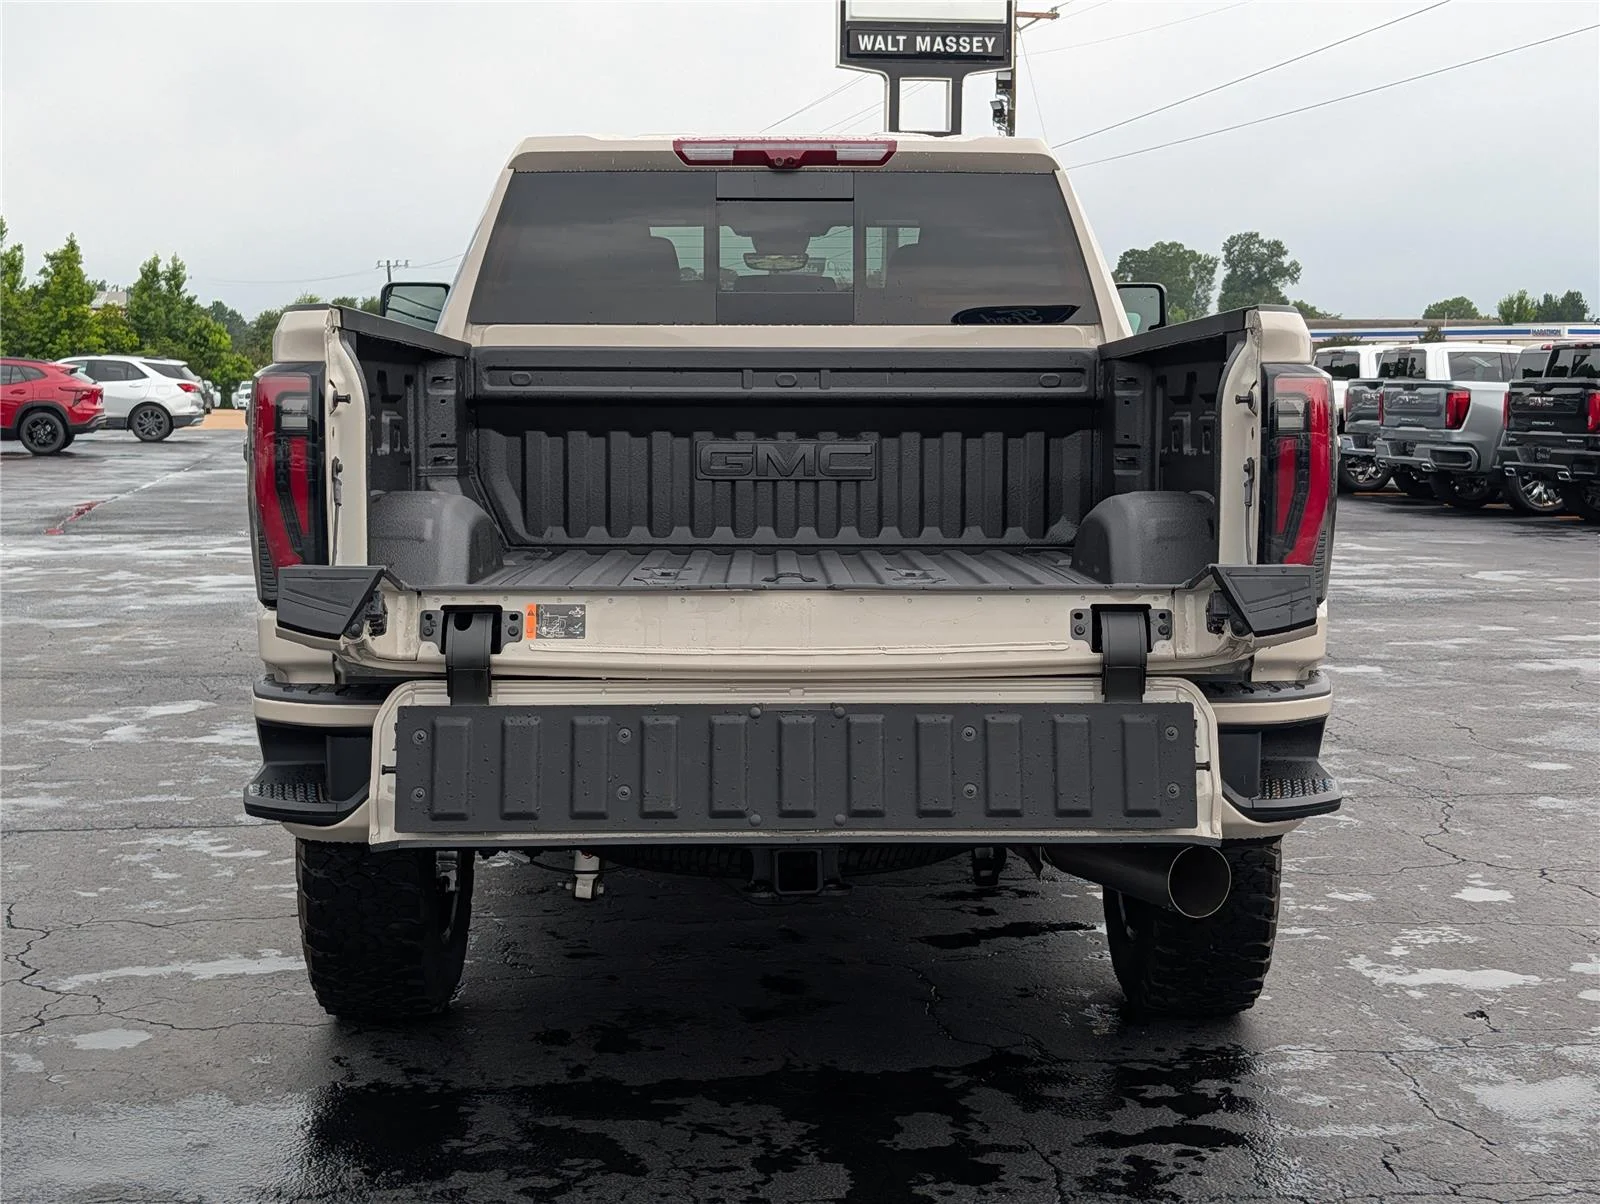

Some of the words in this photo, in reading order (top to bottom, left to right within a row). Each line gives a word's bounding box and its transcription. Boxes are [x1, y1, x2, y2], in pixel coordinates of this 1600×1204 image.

[857, 34, 908, 51] WALT
[915, 35, 996, 53] MASSEY
[1531, 328, 1562, 337] MARATHON
[700, 443, 872, 477] GMC
